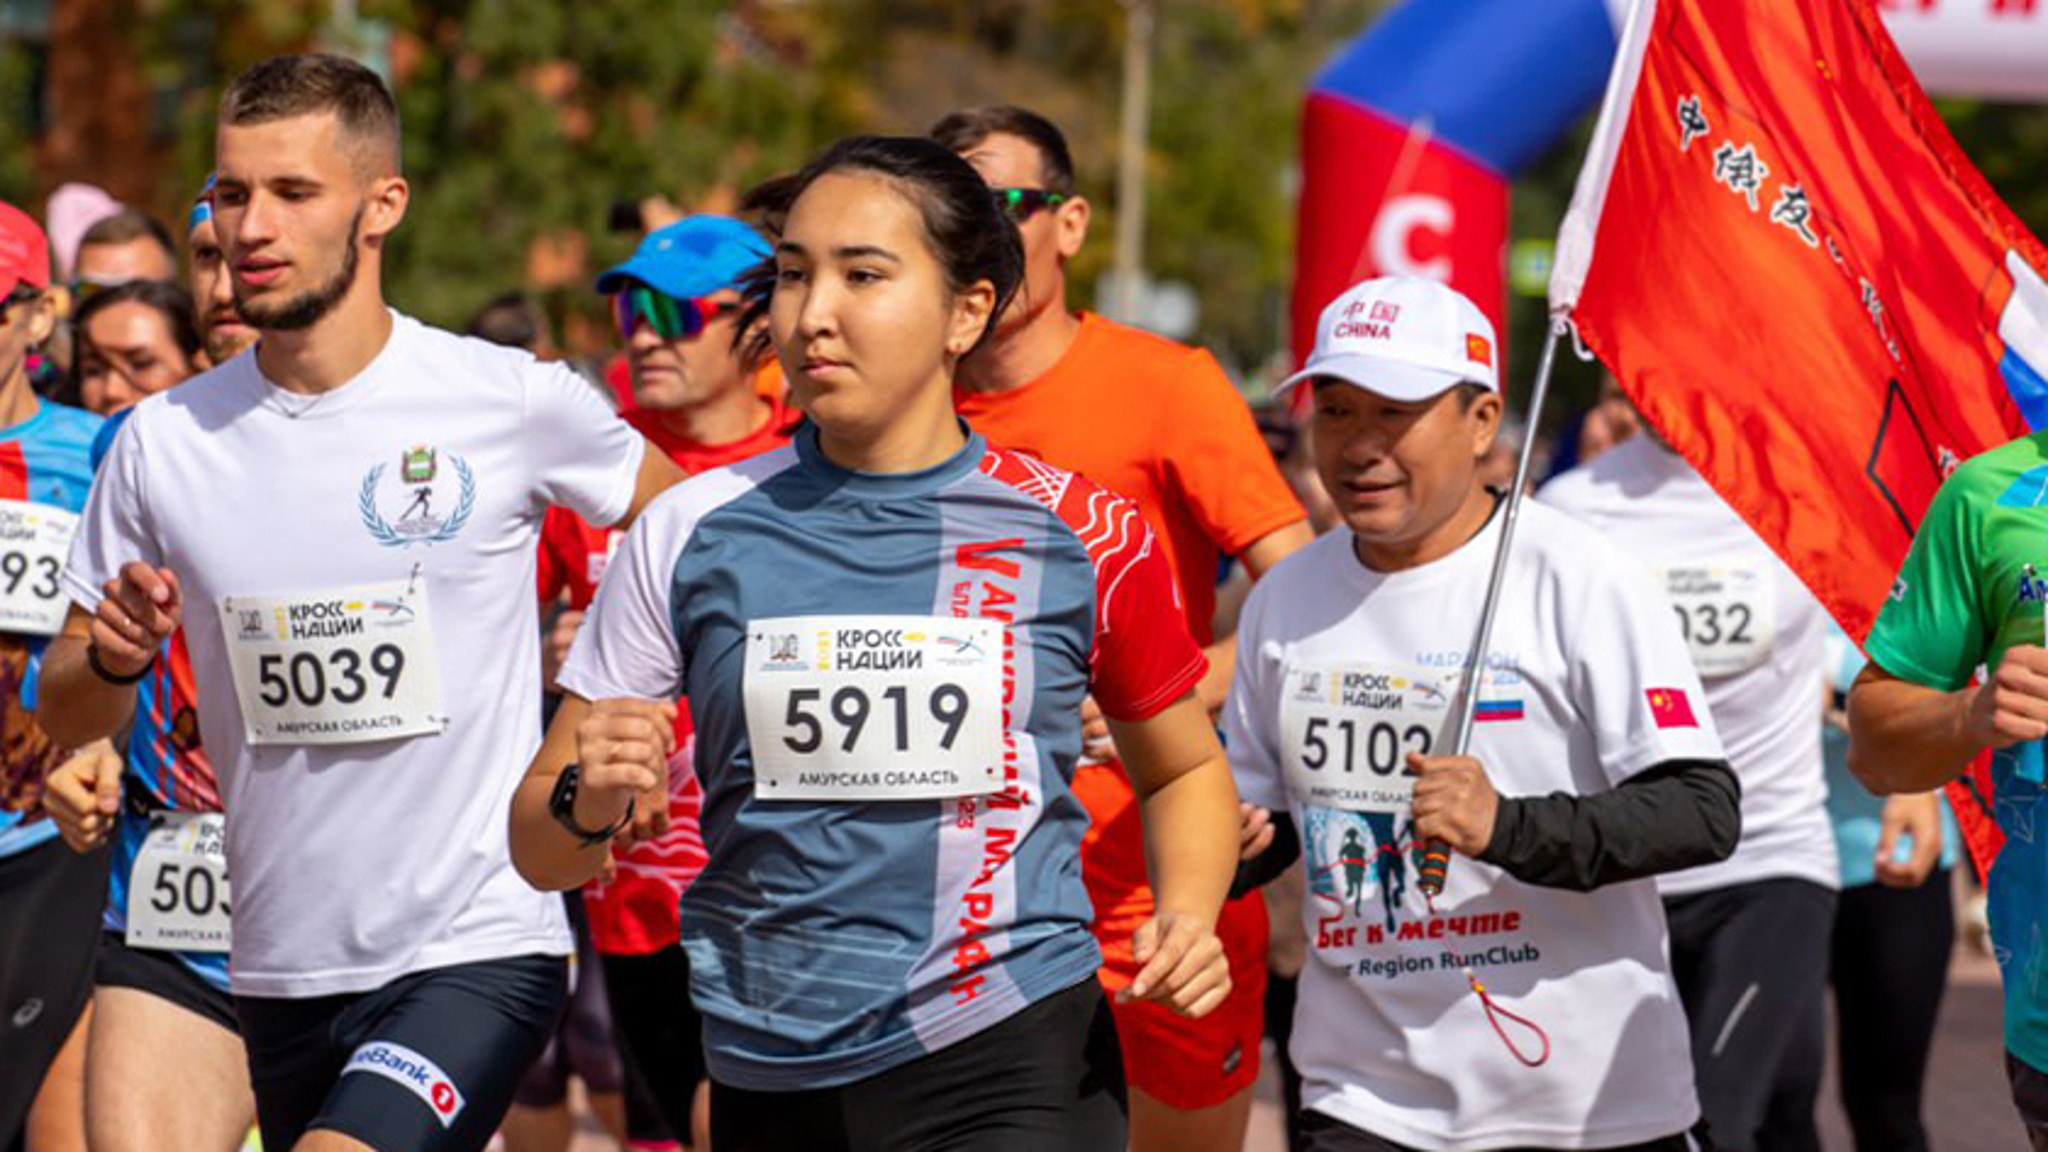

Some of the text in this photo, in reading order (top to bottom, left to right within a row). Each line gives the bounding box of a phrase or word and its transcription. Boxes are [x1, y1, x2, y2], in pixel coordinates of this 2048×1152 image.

[1334, 322, 1391, 339] CHINA
[954, 537, 1025, 578] V
[289, 602, 344, 621] КРОСС
[292, 618, 364, 640] НАЦИИ
[837, 630, 903, 648] КРОСС
[837, 650, 923, 672] НАЦИИ
[259, 643, 405, 707] 5039
[1344, 673, 1391, 690] КРОСС
[1342, 691, 1404, 711] НАЦИИ
[341, 715, 403, 732] ОБЛАСТЬ
[782, 683, 970, 755] 5919
[1301, 717, 1433, 777] 5102
[799, 771, 960, 787] АМУРСКАЯ ОБЛАСТЬ
[1359, 954, 1433, 978] Region
[1440, 943, 1540, 969] RunClub
